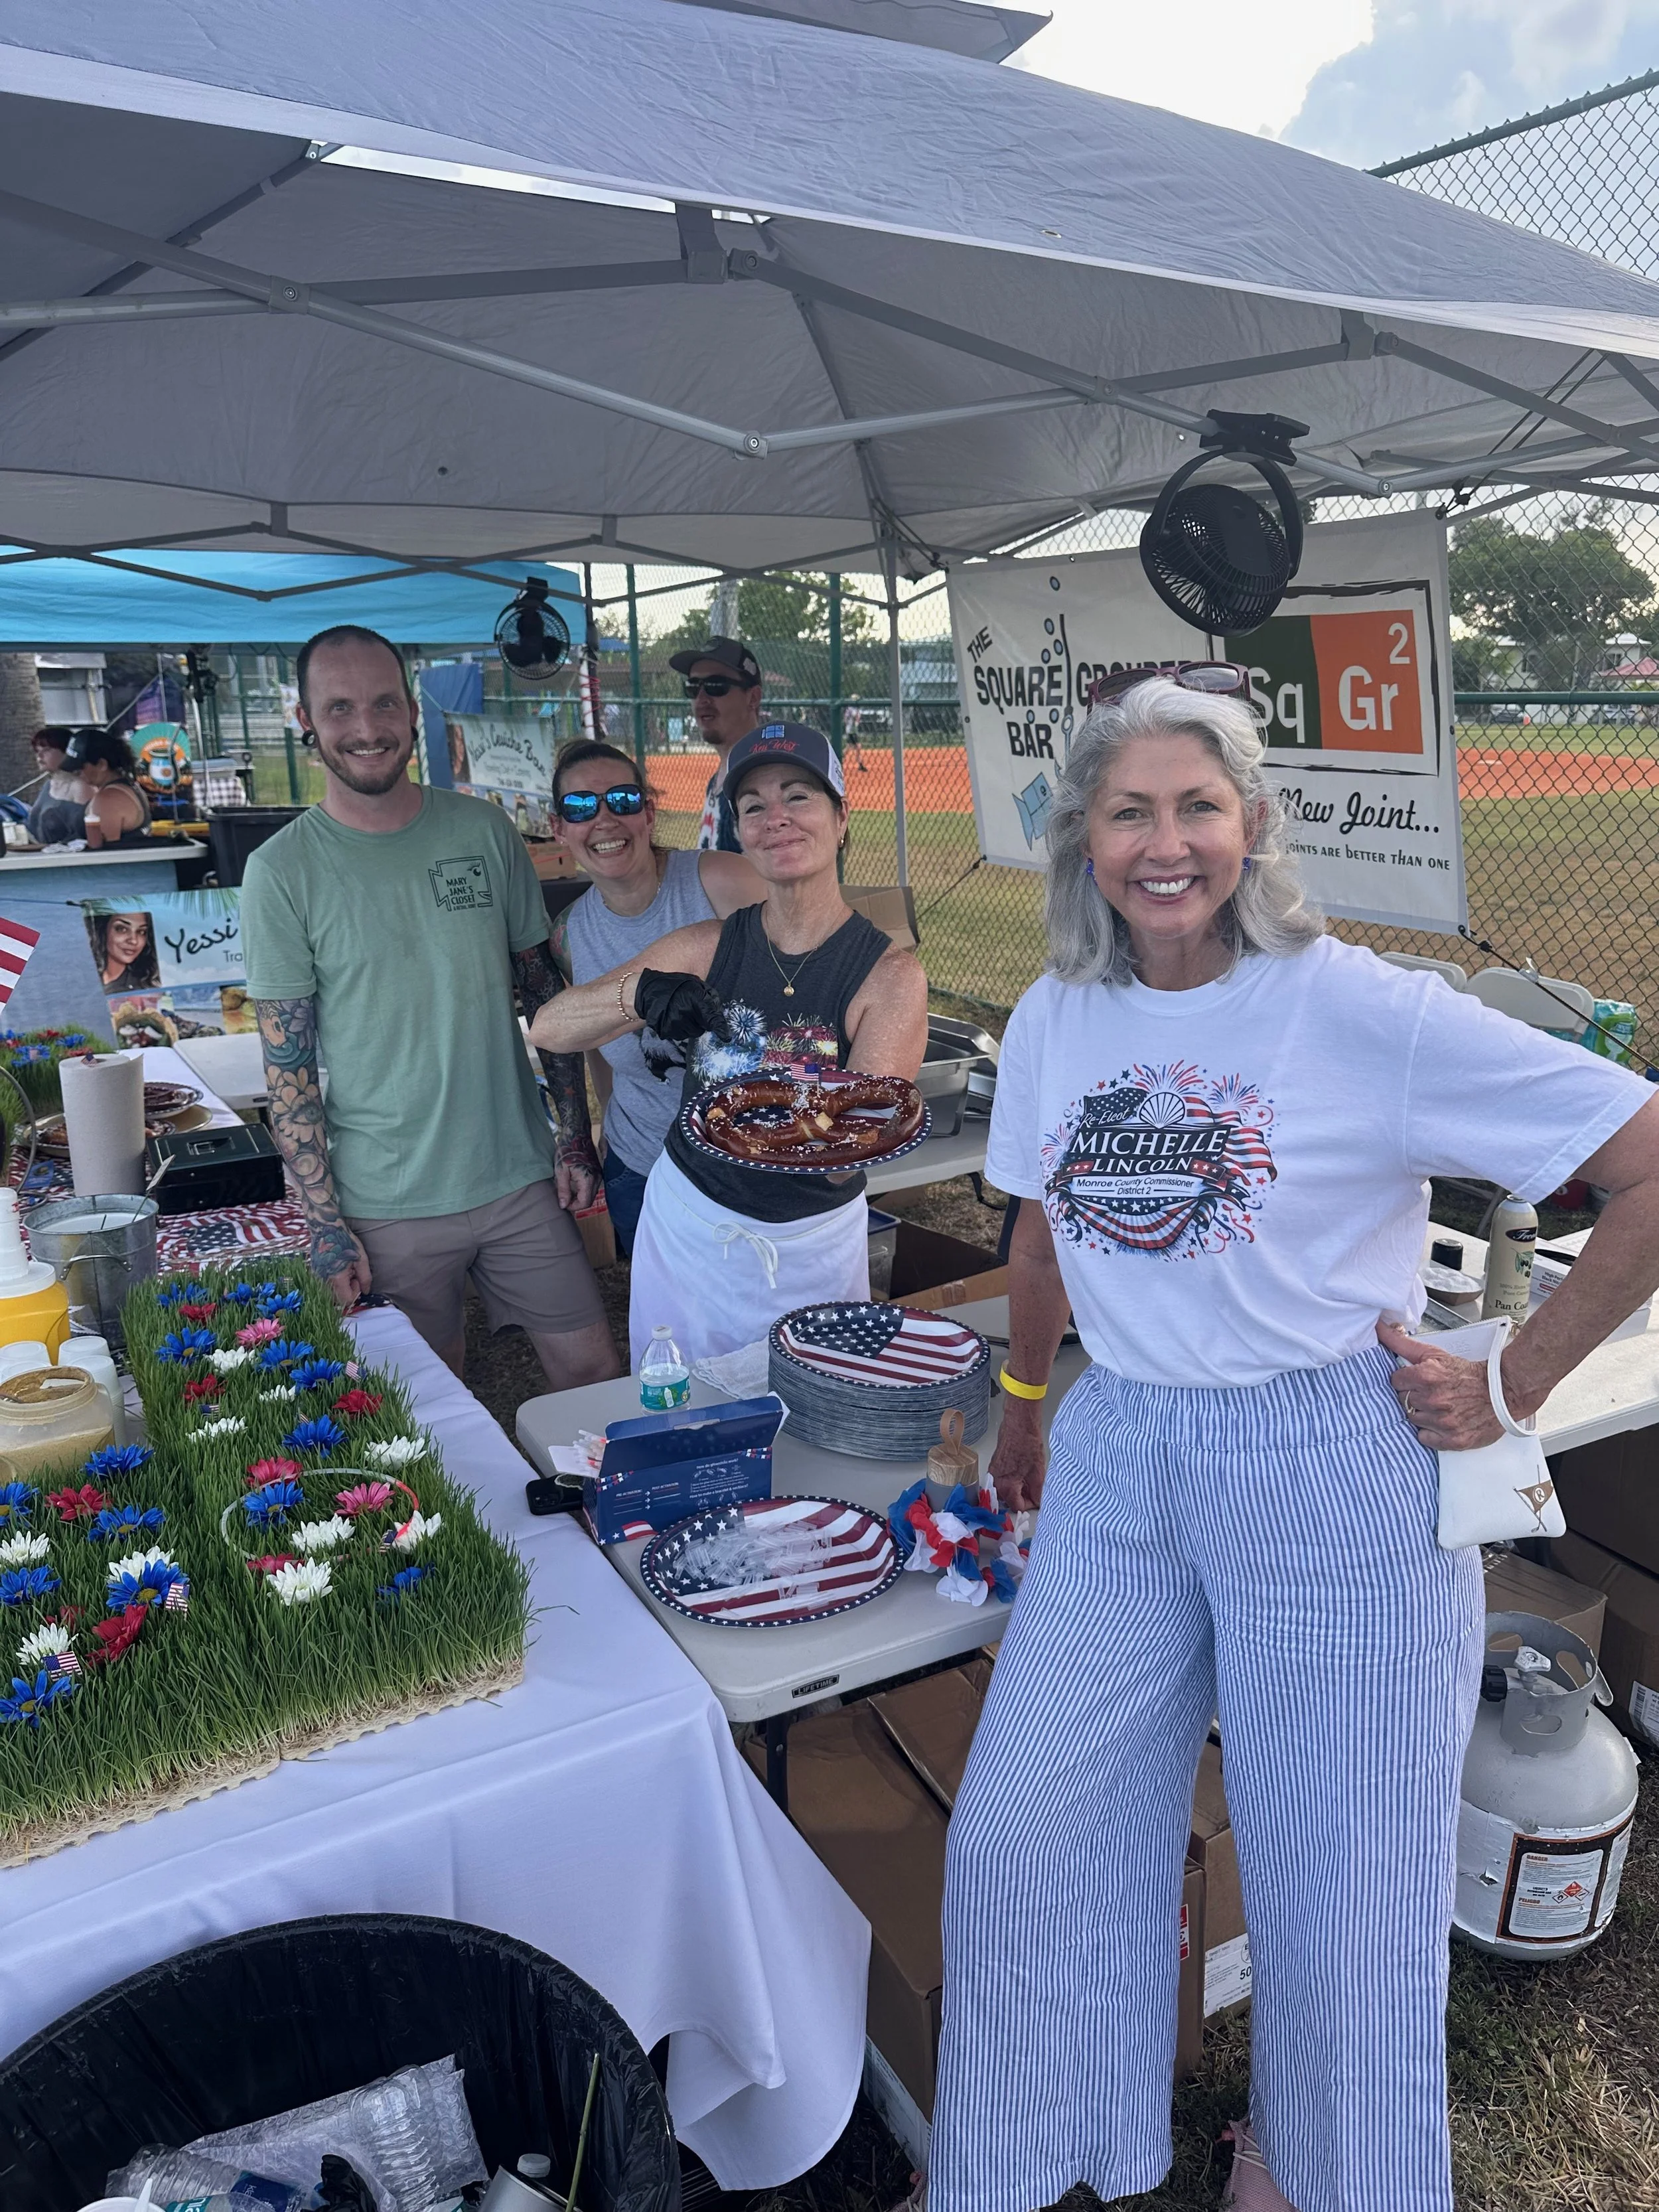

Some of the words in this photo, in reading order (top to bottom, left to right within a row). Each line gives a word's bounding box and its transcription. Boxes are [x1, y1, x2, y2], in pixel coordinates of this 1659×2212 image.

[967, 626, 993, 663] THE
[1388, 623, 1410, 664] 2
[974, 664, 1062, 714] SQUARE
[1247, 666, 1305, 743] Sq
[1338, 666, 1399, 731] Gr
[1007, 721, 1054, 759] BAR
[1339, 792, 1439, 835] Joint...
[1321, 846, 1341, 858] ARE
[1428, 857, 1450, 870] ONE
[446, 877, 467, 887] MARY
[449, 885, 474, 896] JANE'S
[451, 895, 475, 905] CLOSET
[1070, 1130, 1228, 1156] MICHELLE
[1091, 1157, 1194, 1174] LINCOLN
[1077, 1179, 1113, 1187] Monroe
[1115, 1177, 1142, 1187] County
[1144, 1177, 1194, 1188] Commissioner
[1495, 1299, 1511, 1310] Pan
[798, 1678, 834, 1694] LIFETIME
